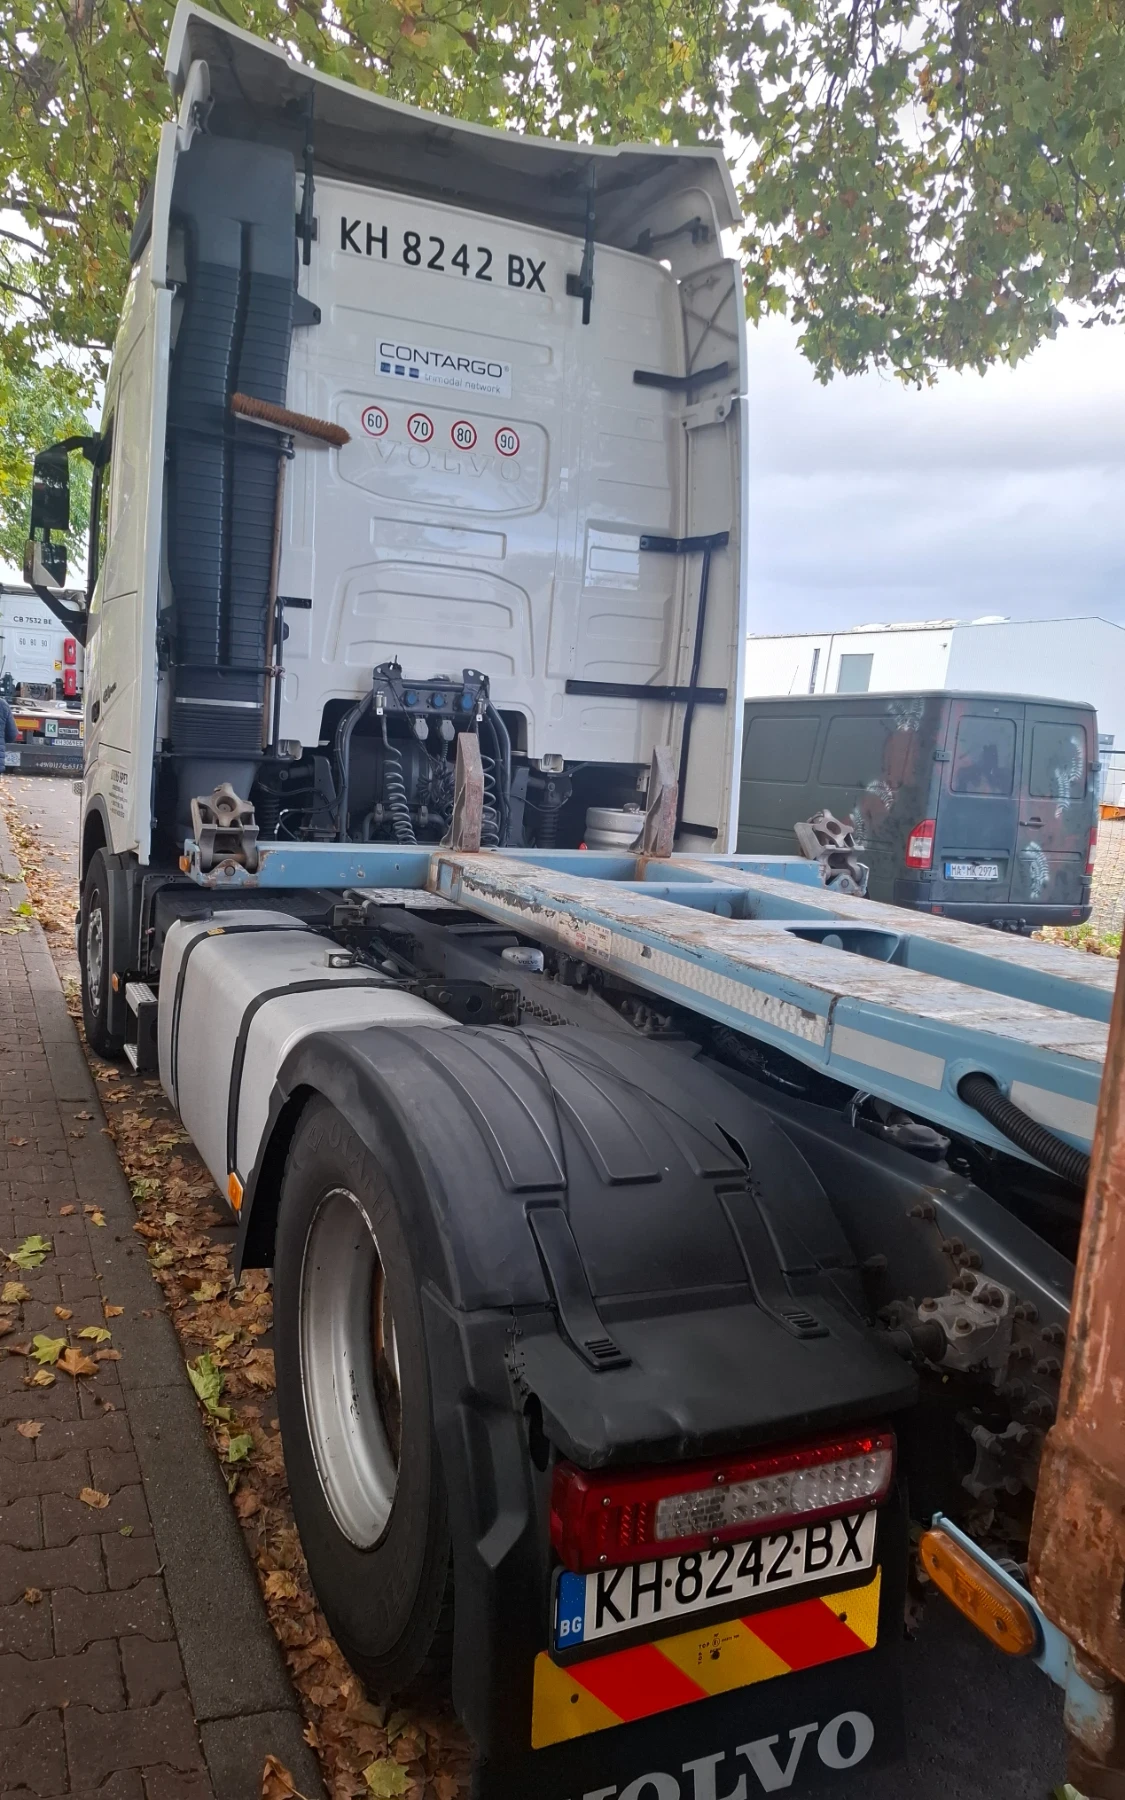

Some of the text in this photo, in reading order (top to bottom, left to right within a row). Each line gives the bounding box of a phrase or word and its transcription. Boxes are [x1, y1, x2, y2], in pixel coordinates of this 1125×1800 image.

[341, 217, 546, 293] KH 8242 BX
[379, 342, 502, 378] CONTARGO
[424, 373, 501, 393] trimodal network
[367, 413, 515, 450] 60 70 80 90
[361, 436, 521, 482] VOLVO
[978, 866, 997, 877] 2971
[594, 1511, 866, 1630] KH 8242 BX
[560, 1618, 582, 1638] BG
[565, 1711, 875, 1800] OLVO
